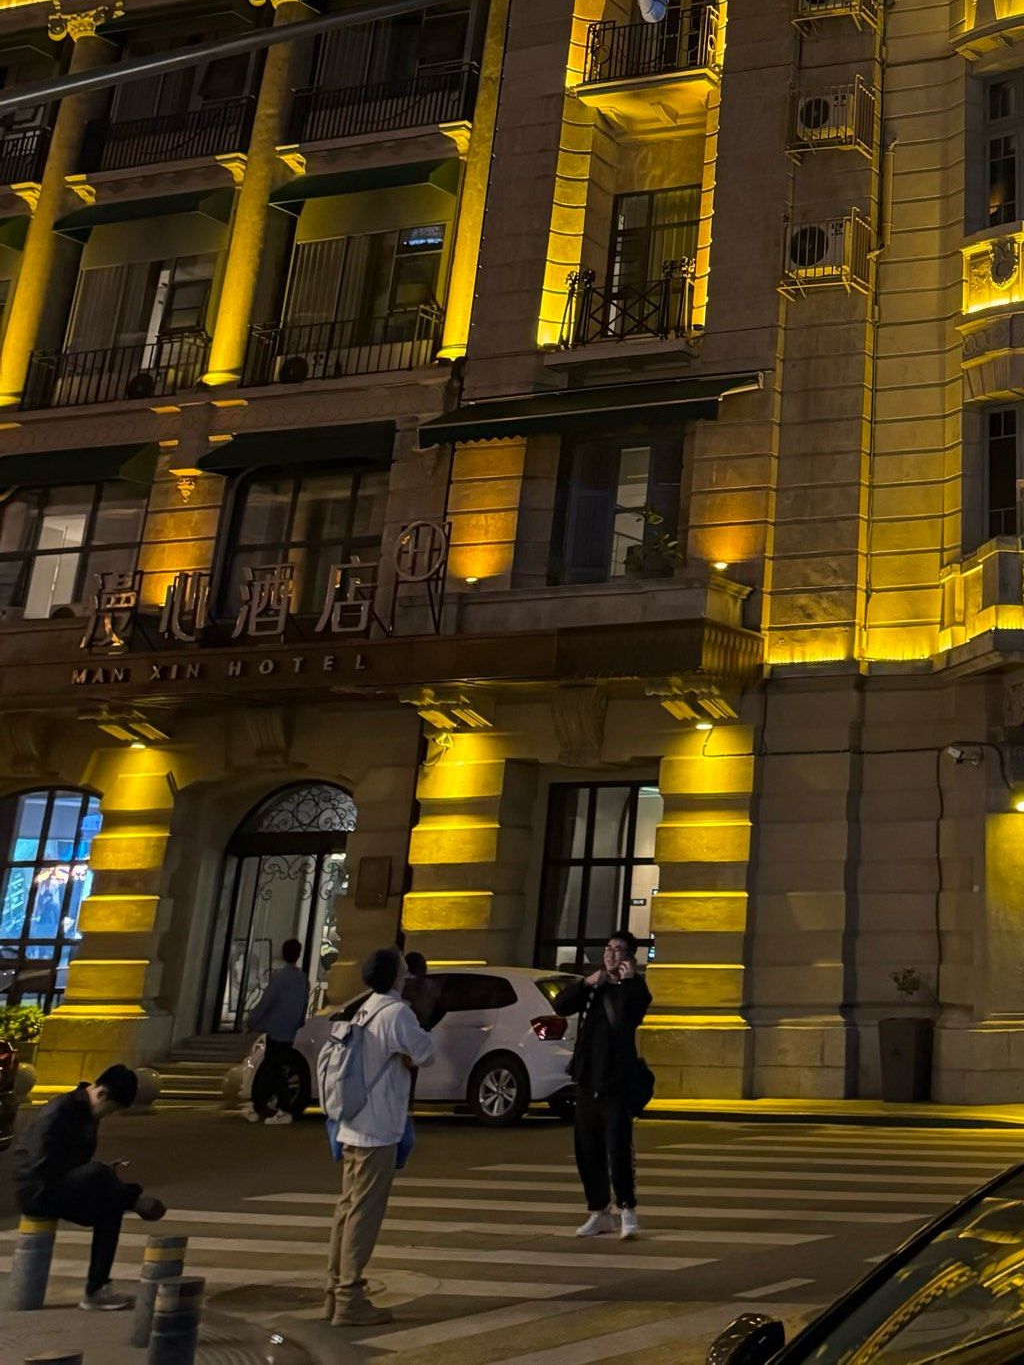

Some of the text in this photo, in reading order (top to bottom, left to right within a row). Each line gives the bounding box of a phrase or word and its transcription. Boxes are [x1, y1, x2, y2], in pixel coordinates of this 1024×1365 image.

[80, 555, 379, 655] 漫心酒店
[71, 653, 367, 685] MAN XIN HOTEL
